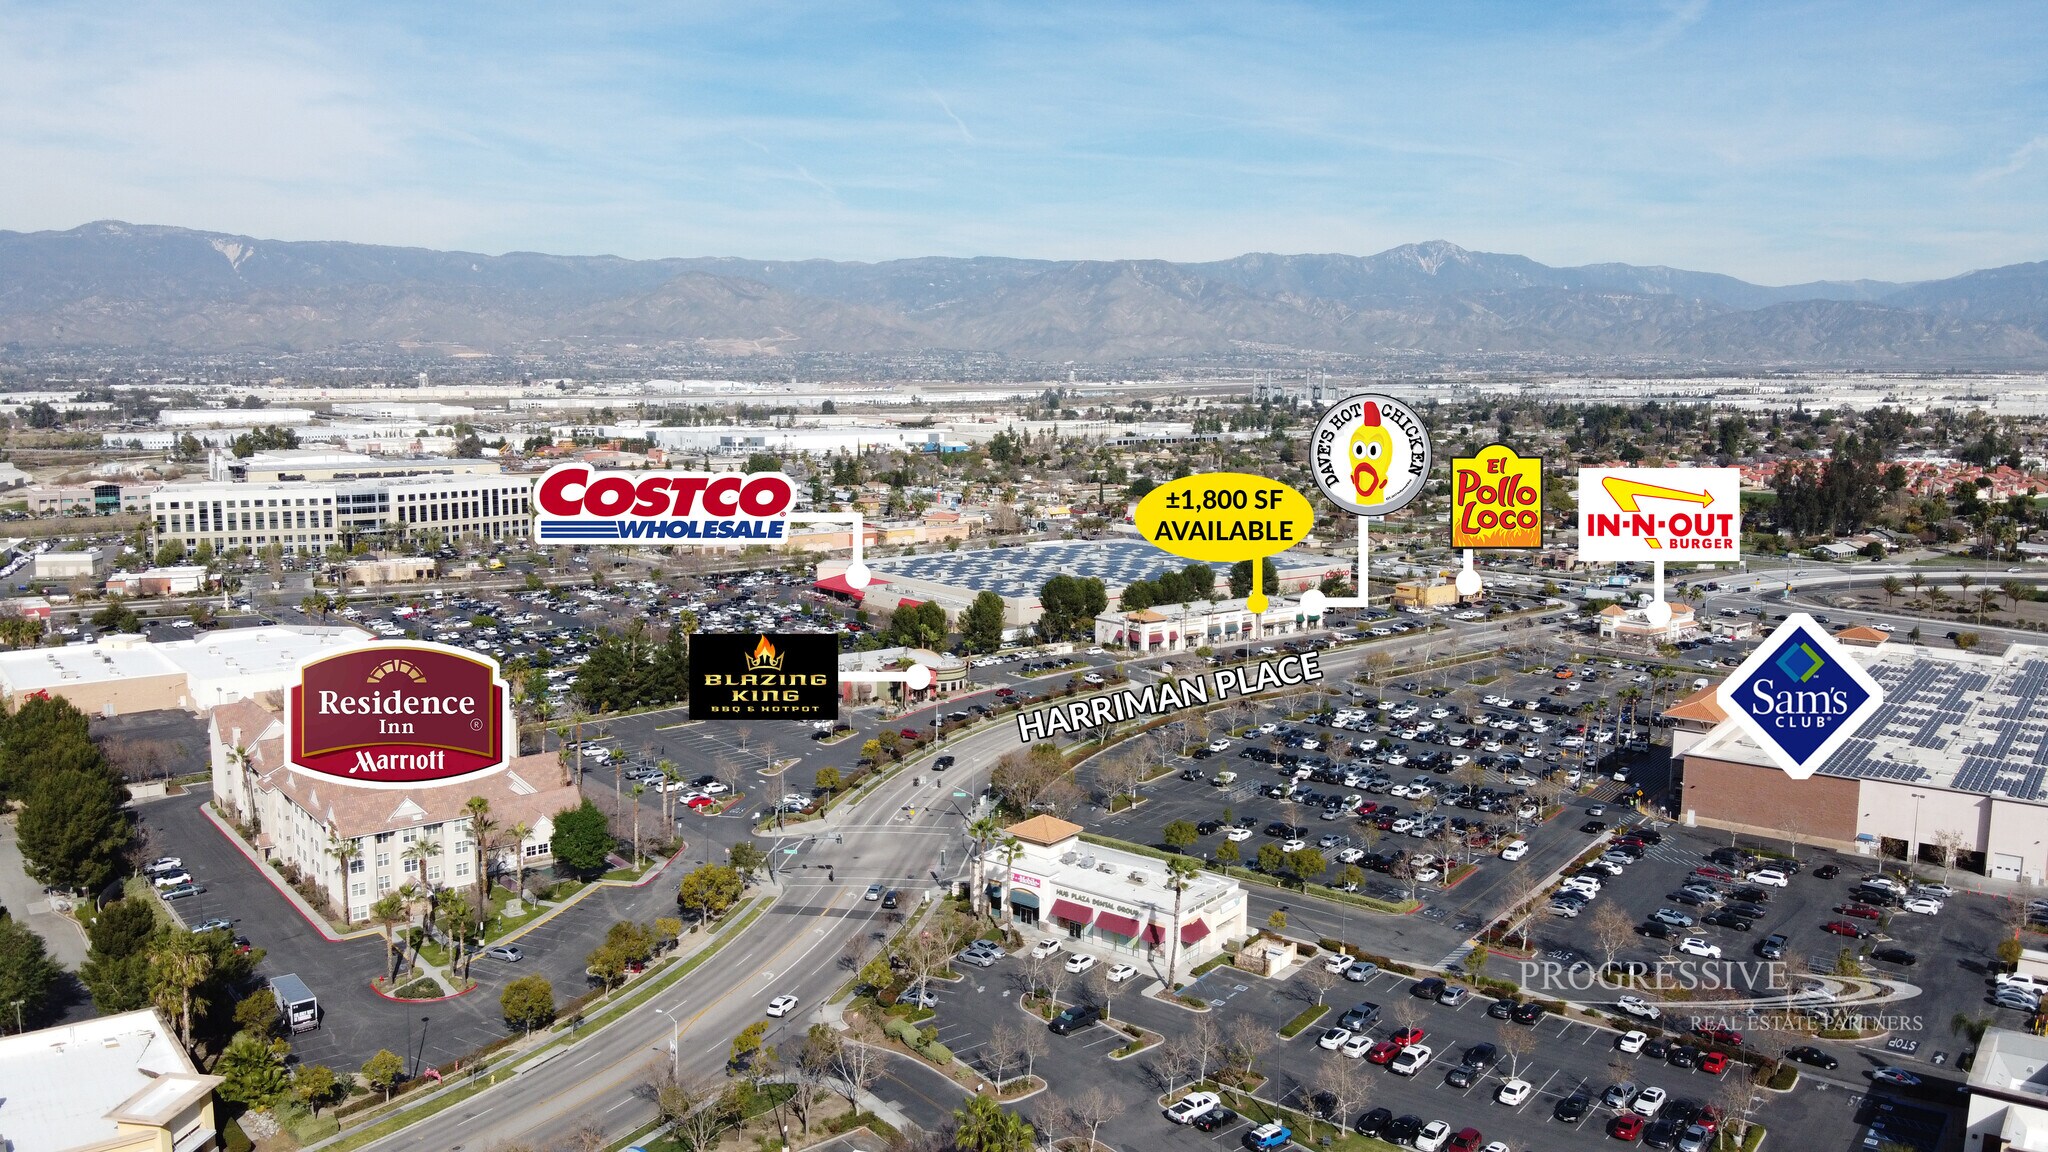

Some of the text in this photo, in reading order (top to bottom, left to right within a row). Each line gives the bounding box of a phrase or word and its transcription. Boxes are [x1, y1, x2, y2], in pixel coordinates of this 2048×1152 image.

[1071, 893, 1090, 904] PLAZA
[1092, 898, 1115, 910] DENTAL
[1888, 1038, 1917, 1050] STOP
